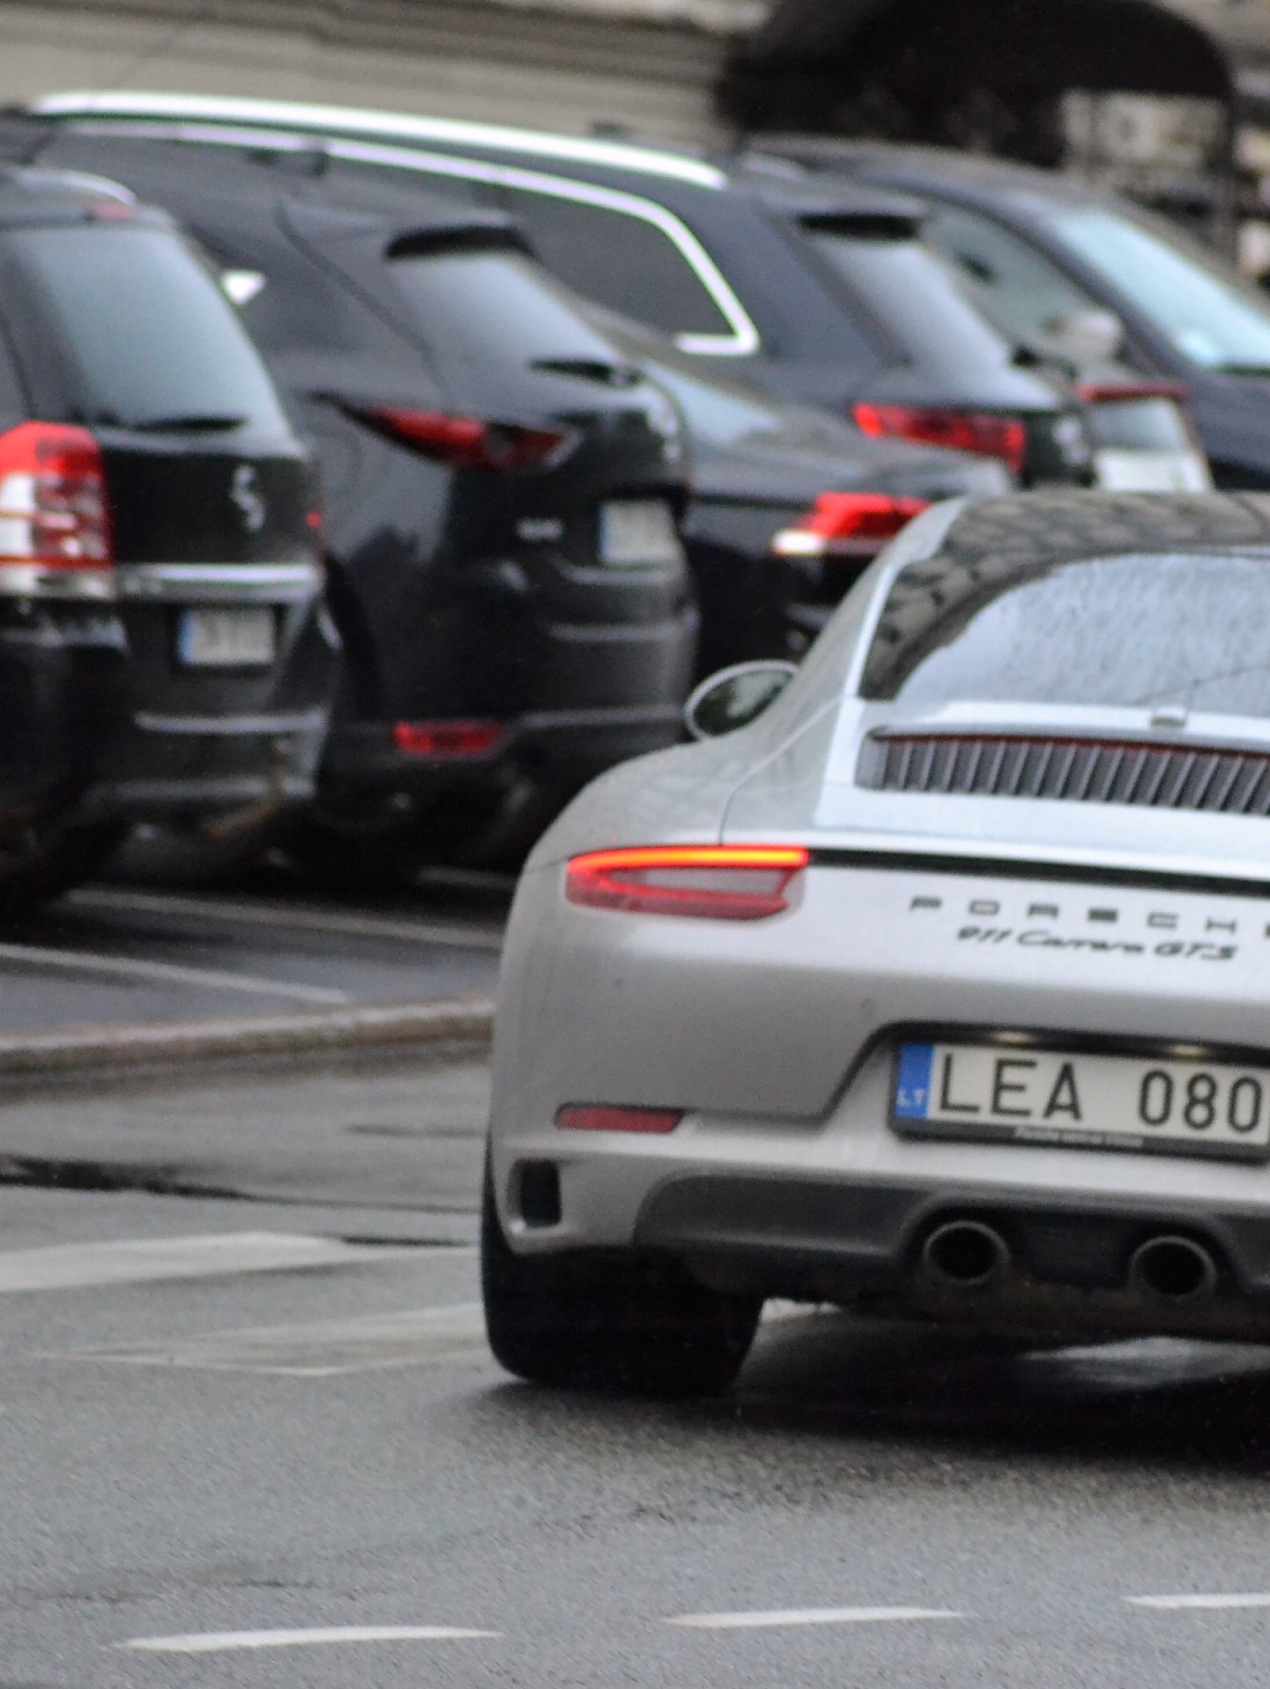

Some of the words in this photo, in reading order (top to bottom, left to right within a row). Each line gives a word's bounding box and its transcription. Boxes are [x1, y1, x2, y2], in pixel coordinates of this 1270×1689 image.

[957, 926, 1013, 943] 911
[1017, 929, 1144, 955] Carrera
[1153, 941, 1239, 961] GTS
[896, 1088, 925, 1108] LT
[939, 1052, 1082, 1122] LEA
[1138, 1070, 1263, 1134] 080
